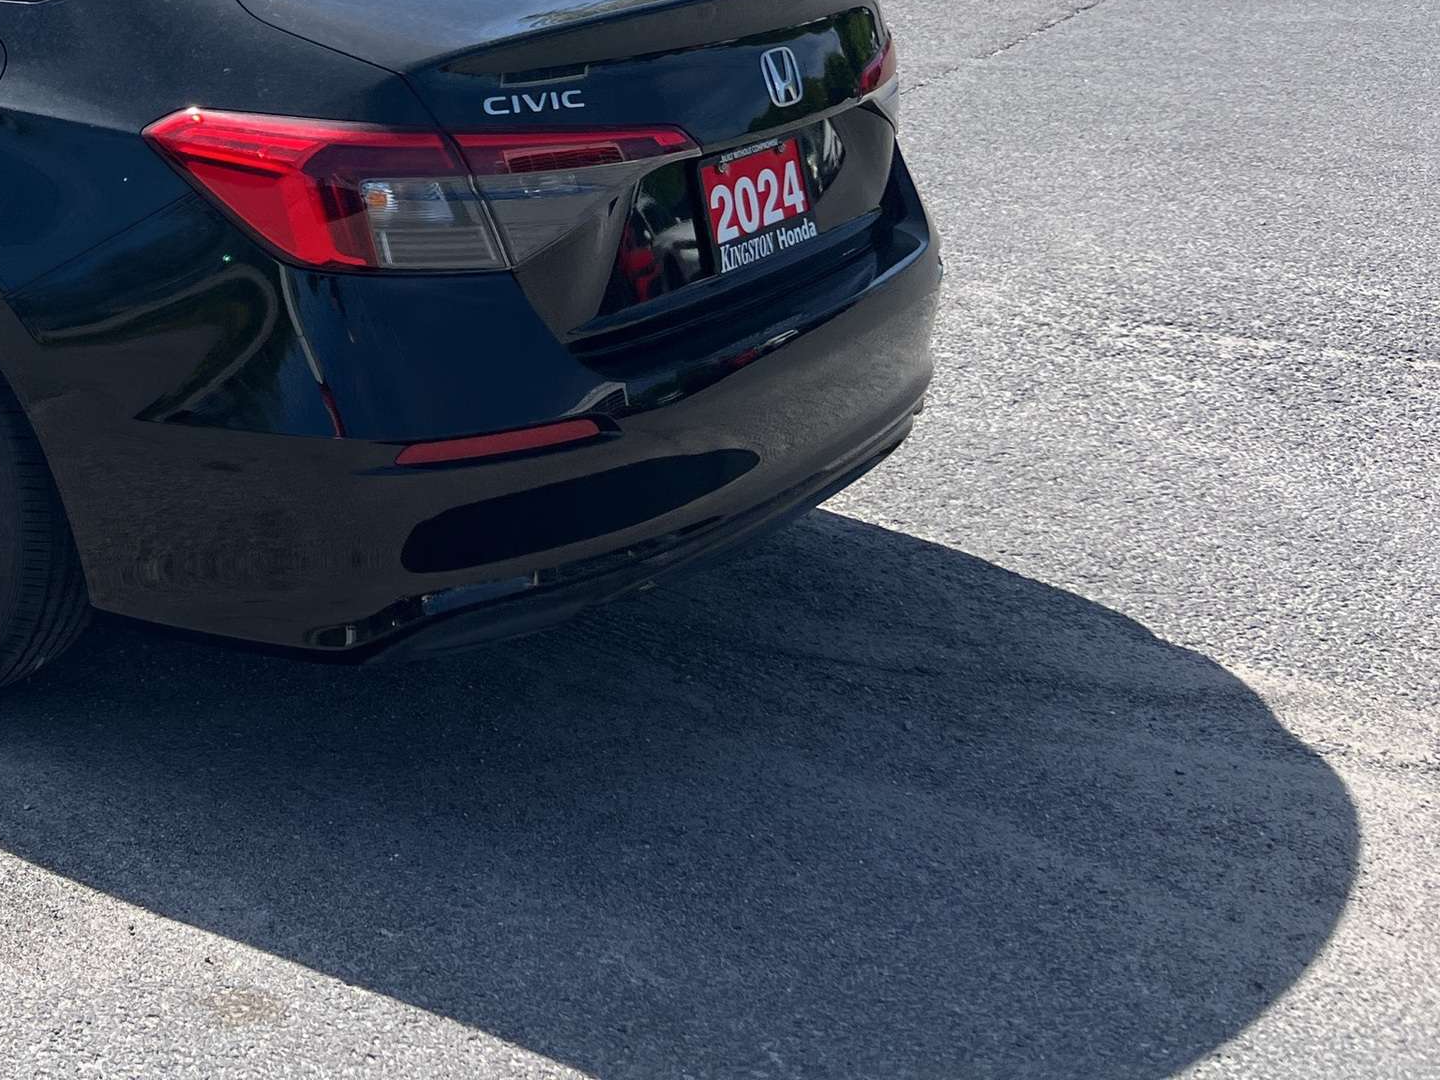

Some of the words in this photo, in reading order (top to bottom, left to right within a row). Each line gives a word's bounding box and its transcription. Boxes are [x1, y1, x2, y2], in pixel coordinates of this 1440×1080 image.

[483, 90, 585, 115] CIVIC
[710, 160, 805, 244] 2024
[720, 232, 774, 273] KINGSTON
[777, 218, 817, 250] Honda
